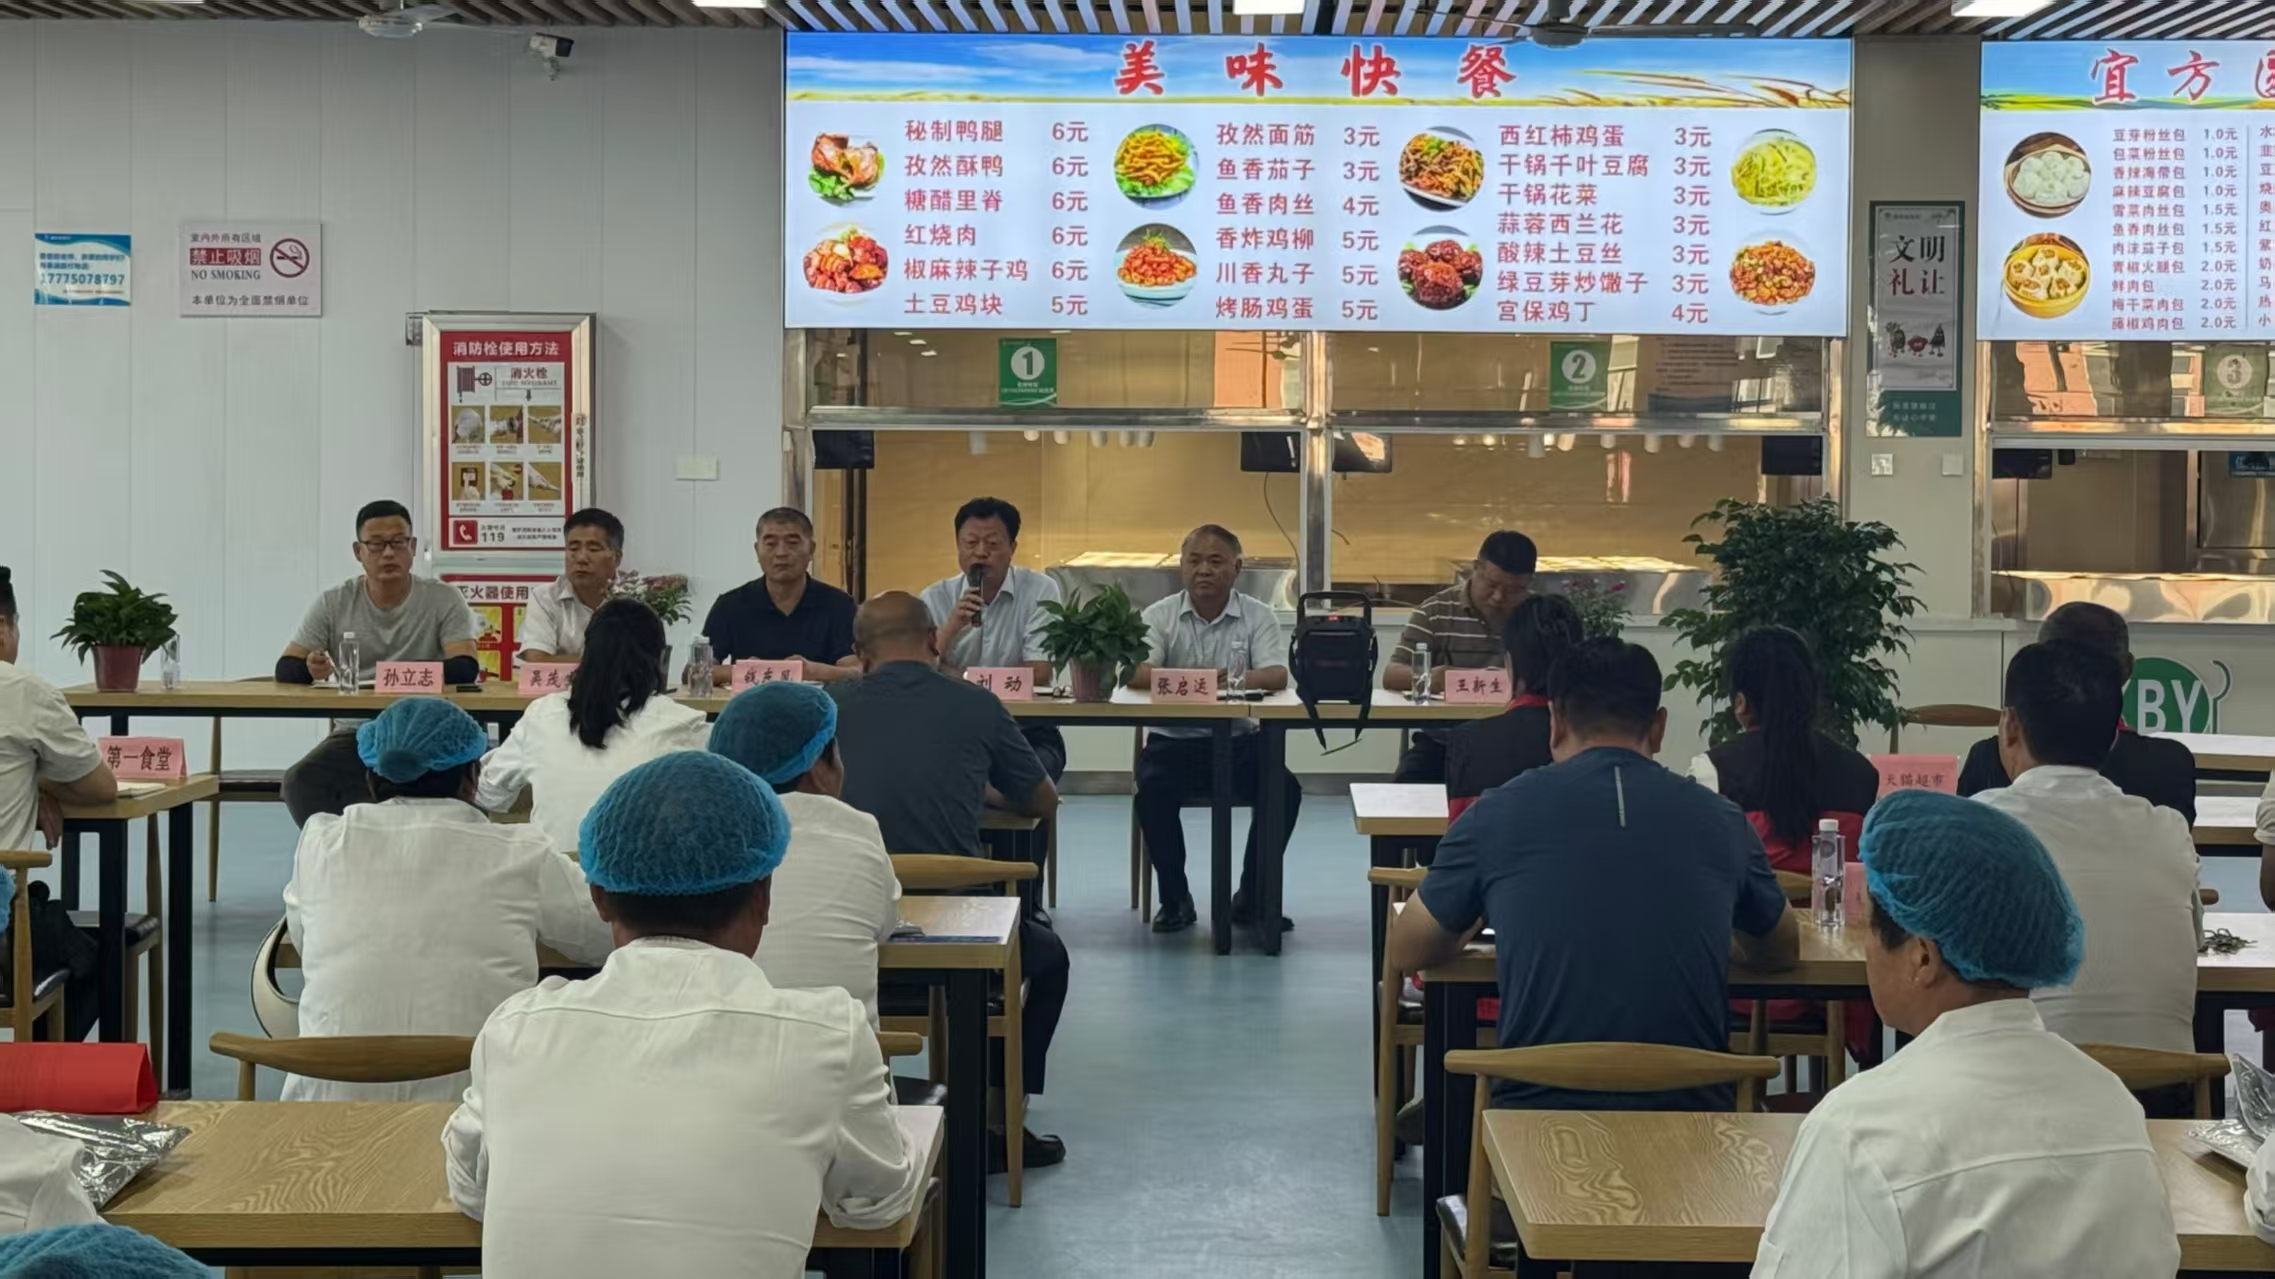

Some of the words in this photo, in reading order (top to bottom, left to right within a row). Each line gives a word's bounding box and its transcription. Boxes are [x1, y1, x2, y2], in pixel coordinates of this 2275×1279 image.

[1115, 42, 1516, 98] 美味快餐
[905, 119, 1003, 143] 秘制鸭腿
[1051, 121, 1089, 143] 6元
[1217, 122, 1315, 146] 孜然面筋
[1343, 125, 1381, 147] 3元
[1498, 124, 1625, 148] 西红柿鸡蛋
[1674, 126, 1712, 148] 3元
[2113, 128, 2185, 142] 豆芽粉丝包
[2204, 127, 2238, 141] 1.0元
[1498, 153, 1649, 177] 干锅千叶豆腐
[1673, 155, 1711, 177] 3元
[2113, 147, 2185, 161] 包菜粉丝包
[2203, 146, 2238, 160] 1.0元
[905, 154, 1003, 177] 孜然酥鸭
[1051, 155, 1089, 178] 6元
[1216, 157, 1315, 181] 鱼香茄子
[1343, 160, 1380, 182] 3元
[2203, 164, 2238, 179] 1.0元
[904, 188, 1002, 212] 糖醋里脊
[1051, 190, 1089, 212] 6元
[1498, 183, 1597, 206] 干锅花菜
[1673, 184, 1711, 207] 3元
[2112, 184, 2185, 199] 麻辣豆腐包
[2204, 183, 2237, 198] 1.0元
[1217, 192, 1315, 216] 鱼香肉丝
[1342, 195, 1380, 217] 4元
[2112, 203, 2185, 218] 雪菜肉丝包
[2203, 202, 2238, 217] 1.5元
[904, 223, 976, 247] 红烧肉
[1051, 225, 1089, 247] 6元
[1497, 211, 1623, 235] 蒜蓉西兰花
[1673, 214, 1710, 236] 3元
[2112, 222, 2185, 237] 鱼香肉丝包
[2202, 221, 2237, 236] 1.5元
[190, 233, 262, 244] 室内外所有区域
[1216, 227, 1314, 251] 香炸鸡柳
[1342, 229, 1379, 251] 5元
[1889, 234, 1945, 264] 文明
[2203, 240, 2237, 254] 1.5元
[191, 249, 261, 266] 禁止吸烟
[1497, 241, 1622, 264] 酸辣土豆丝
[1672, 243, 1710, 265] 3元
[191, 270, 207, 281] NO
[210, 270, 261, 281] SMOKING
[903, 257, 1028, 282] 椒麻辣子鸡
[1051, 260, 1089, 281] 6元
[1216, 261, 1315, 285] 川香丸子
[1342, 264, 1379, 286] 5元
[2112, 260, 2185, 274] 青椒火腿包
[2201, 259, 2237, 273] 2.0元
[1497, 270, 1648, 294] 绿豆芽炒馓子
[1672, 273, 1710, 295] 3元
[1889, 267, 1945, 297] 礼让
[2111, 279, 2155, 293] 鲜肉包
[2201, 278, 2237, 292] 2.0元
[903, 292, 1003, 316] 土豆鸡块
[1051, 294, 1088, 316] 5元
[1215, 296, 1313, 320] 烤肠鸡蛋
[1342, 299, 1378, 321] 5元
[1497, 299, 1595, 323] 宫保鸡丁
[1671, 302, 1709, 324] 4元
[2111, 297, 2184, 312] 梅干菜肉包
[2200, 296, 2237, 311] 2.0元
[2111, 316, 2184, 331] 藤椒鸡肉包
[2200, 315, 2237, 329] 2.0元
[453, 341, 559, 357] 消防栓使用方法
[511, 366, 548, 380] 消火栓
[1022, 350, 1034, 376] 1
[1571, 353, 1587, 380] 2
[2226, 357, 2242, 385] 3
[481, 532, 505, 542] 119
[458, 586, 536, 600] 灭火器使用
[382, 667, 435, 689] 孙立志
[1004, 675, 1022, 692] 动
[1456, 676, 1503, 696] 王新生
[2136, 678, 2201, 735] BY
[106, 745, 173, 771] 第一食堂
[1886, 772, 1944, 787] 天猫超市
